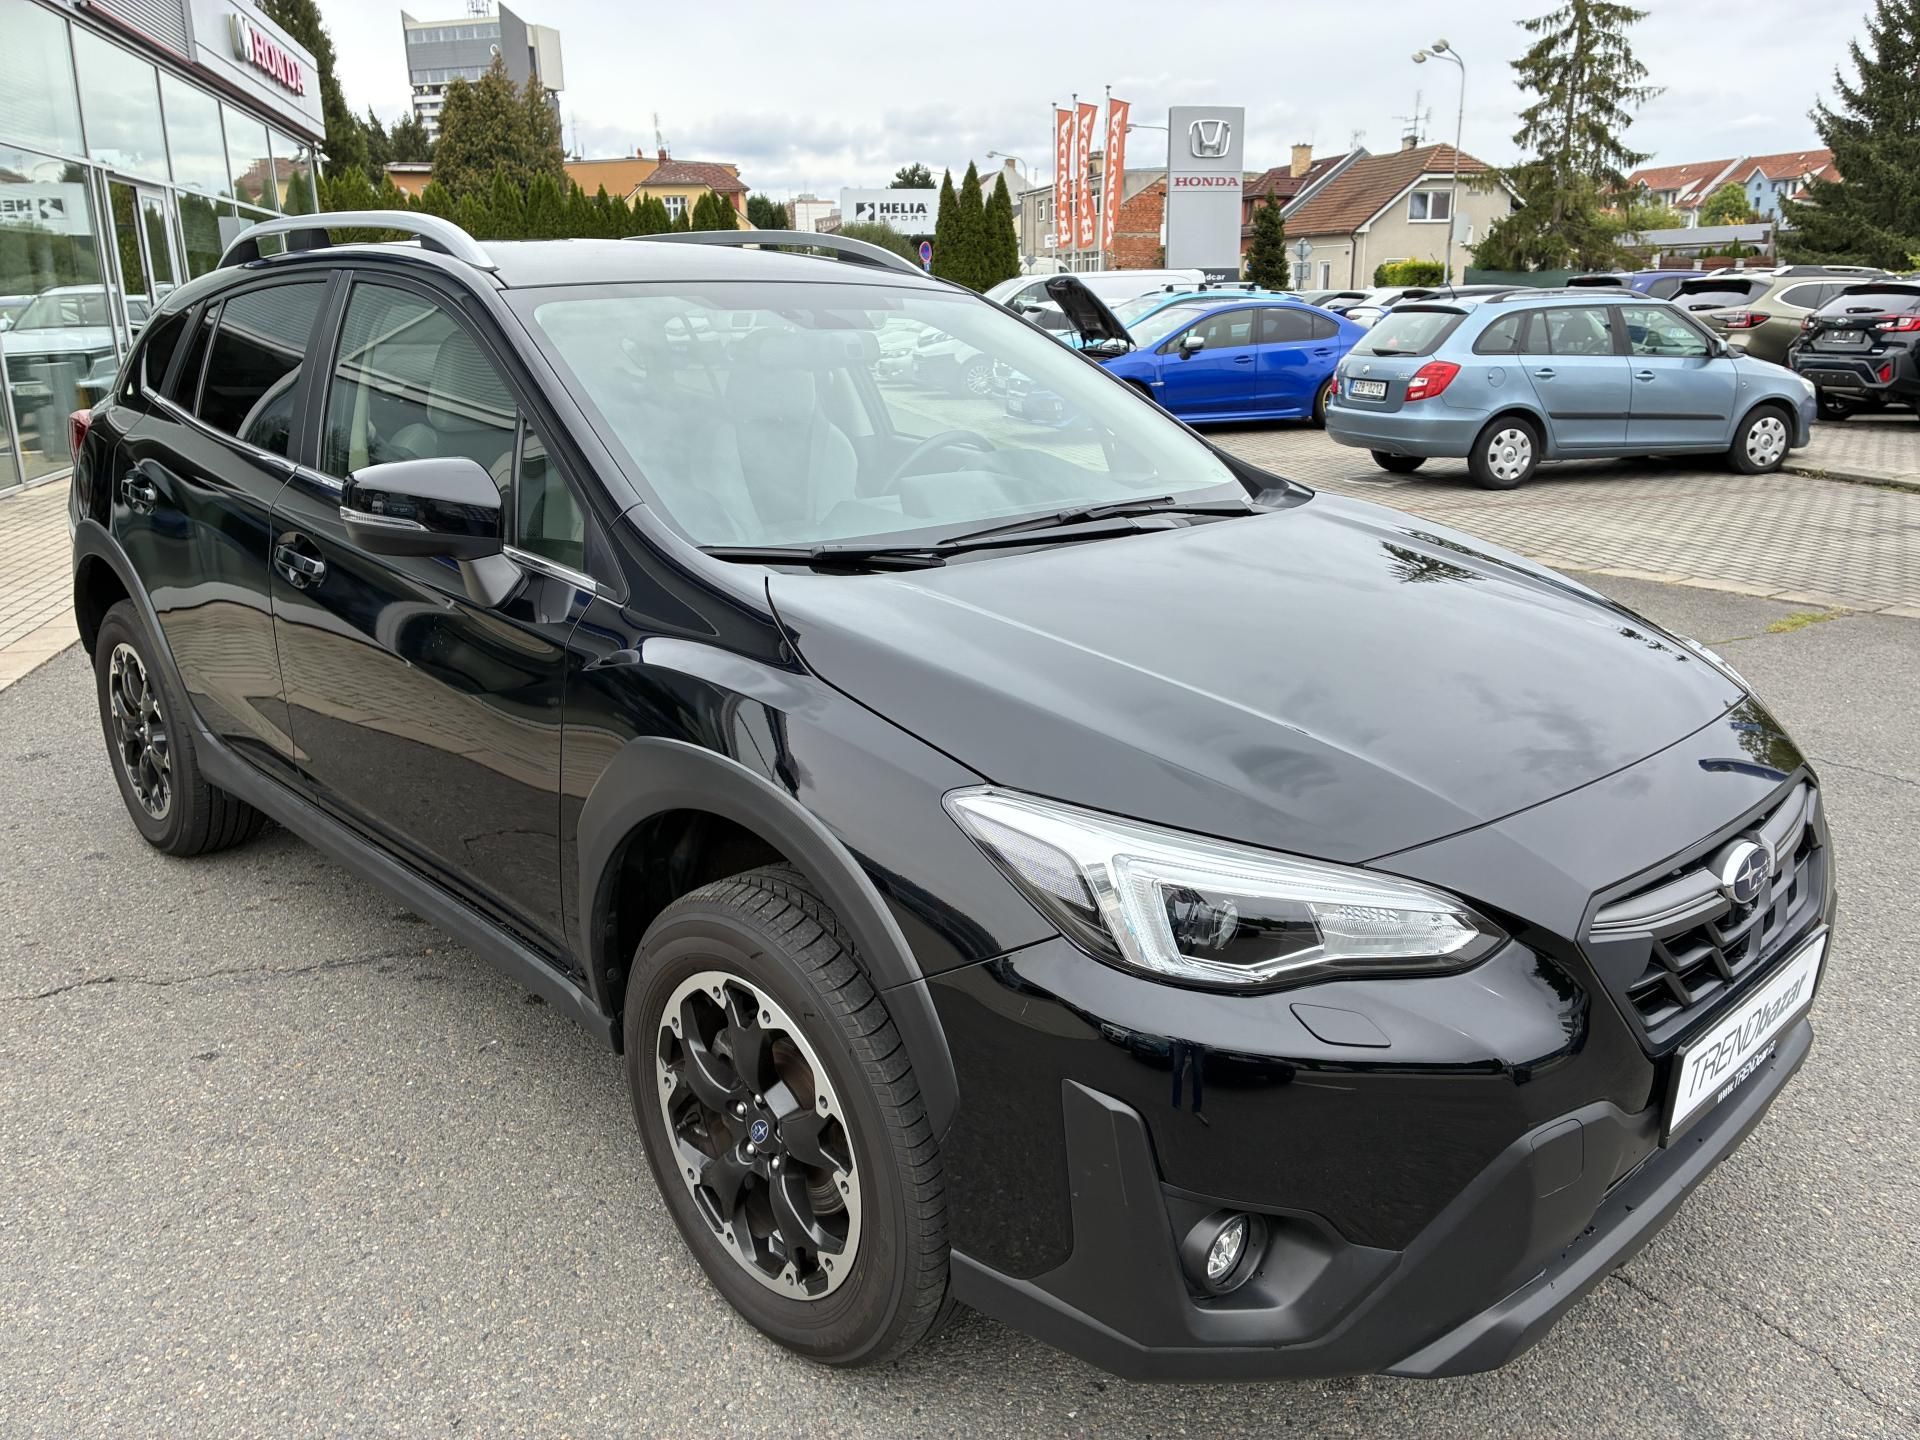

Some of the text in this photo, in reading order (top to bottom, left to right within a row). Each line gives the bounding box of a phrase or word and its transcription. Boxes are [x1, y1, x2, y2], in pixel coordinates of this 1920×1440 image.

[250, 27, 304, 95] HONDA
[880, 202, 927, 214] HELIA
[1079, 110, 1093, 243] HONDA
[1174, 177, 1239, 187] HONDA
[1689, 970, 1808, 1098] TRENDbazar
